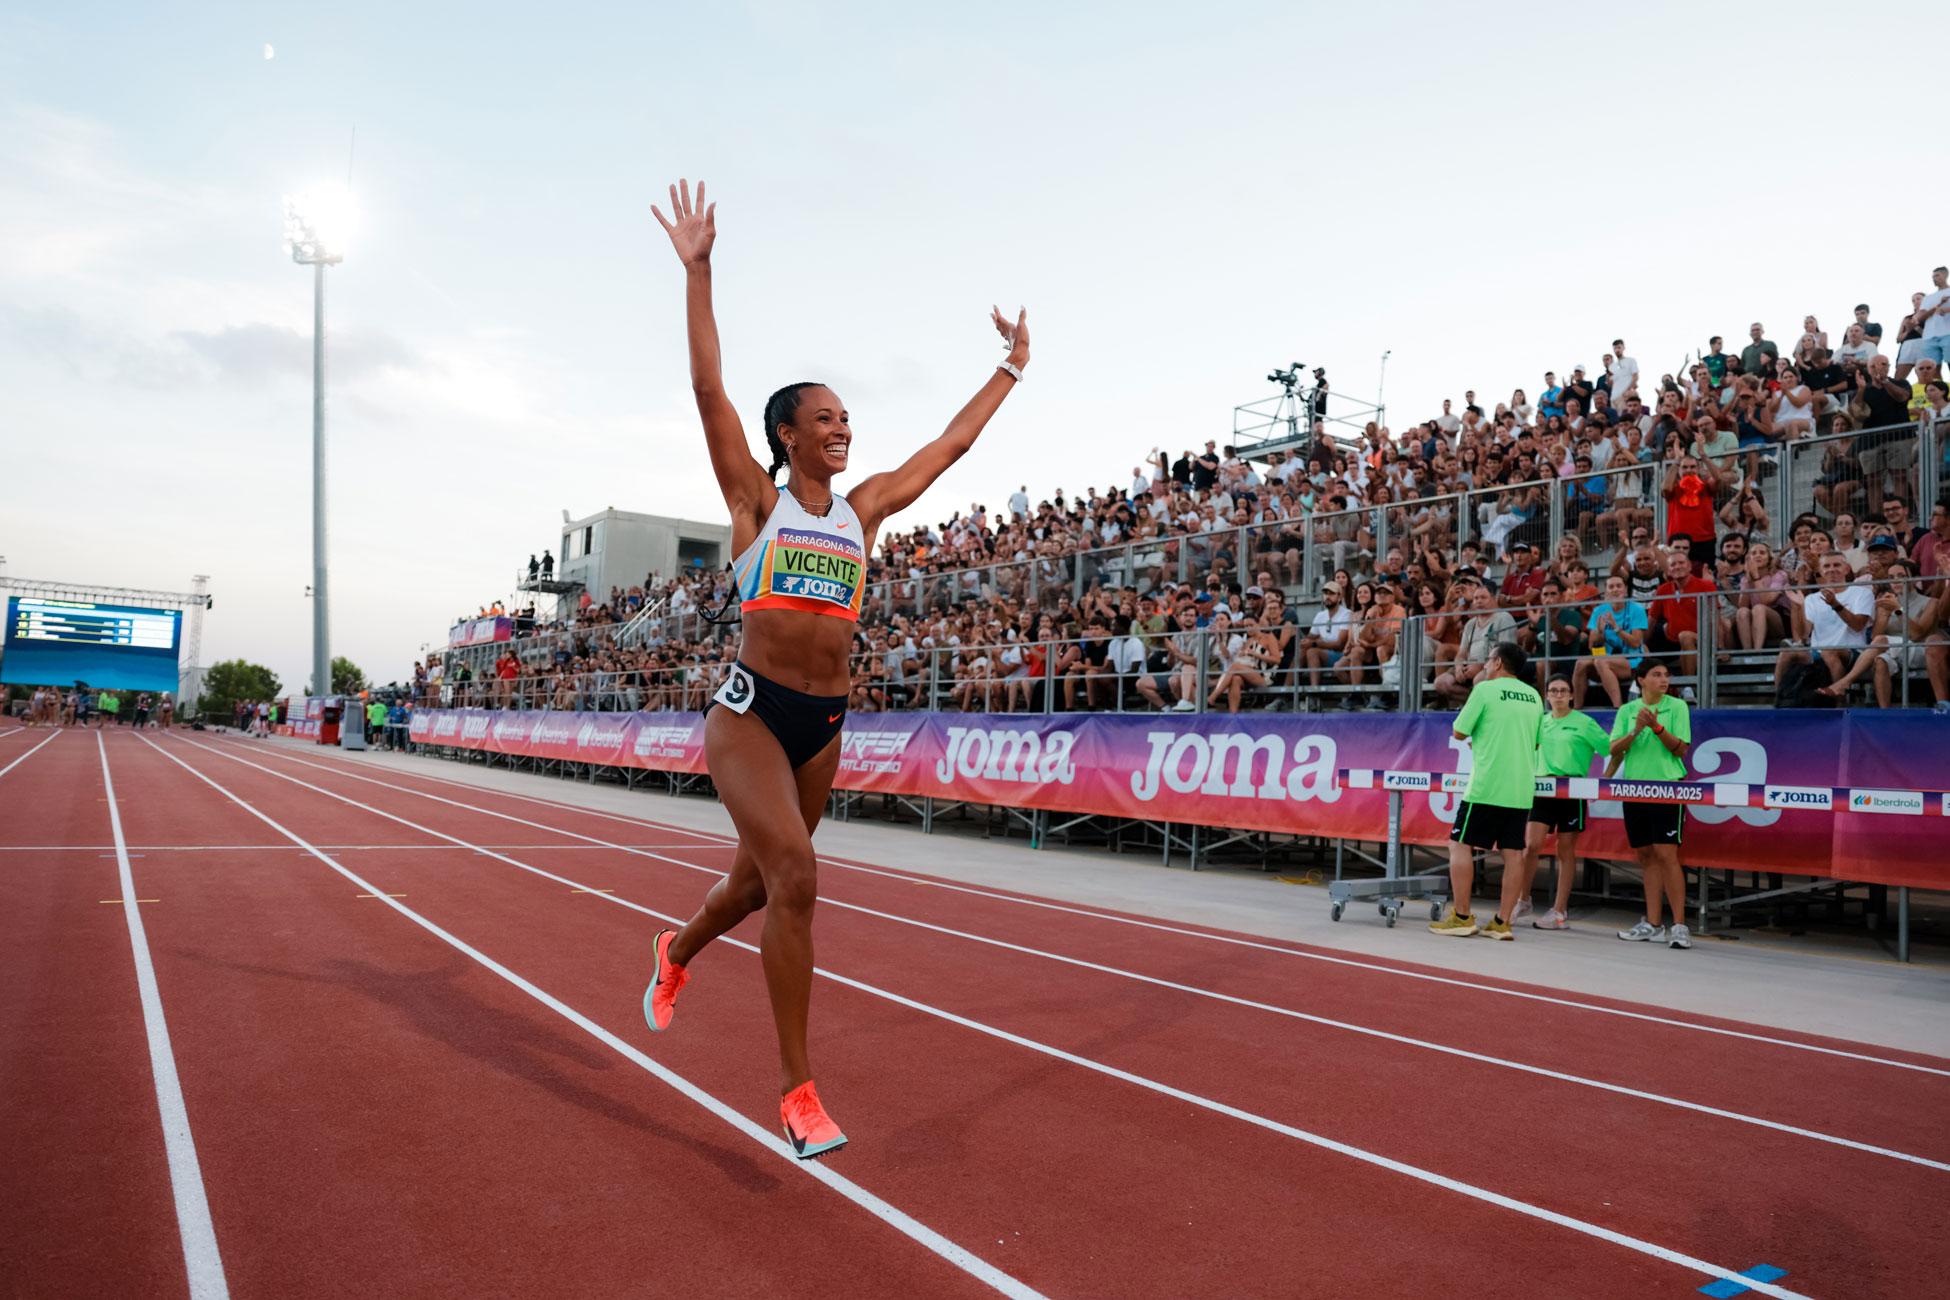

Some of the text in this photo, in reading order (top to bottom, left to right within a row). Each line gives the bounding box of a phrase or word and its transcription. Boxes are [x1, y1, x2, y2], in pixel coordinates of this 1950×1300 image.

[782, 533, 844, 552] TARRAGONA
[784, 549, 856, 584] VICENTE
[725, 671, 750, 704] 9
[1609, 783, 1703, 801] TARRAGONA 2025
